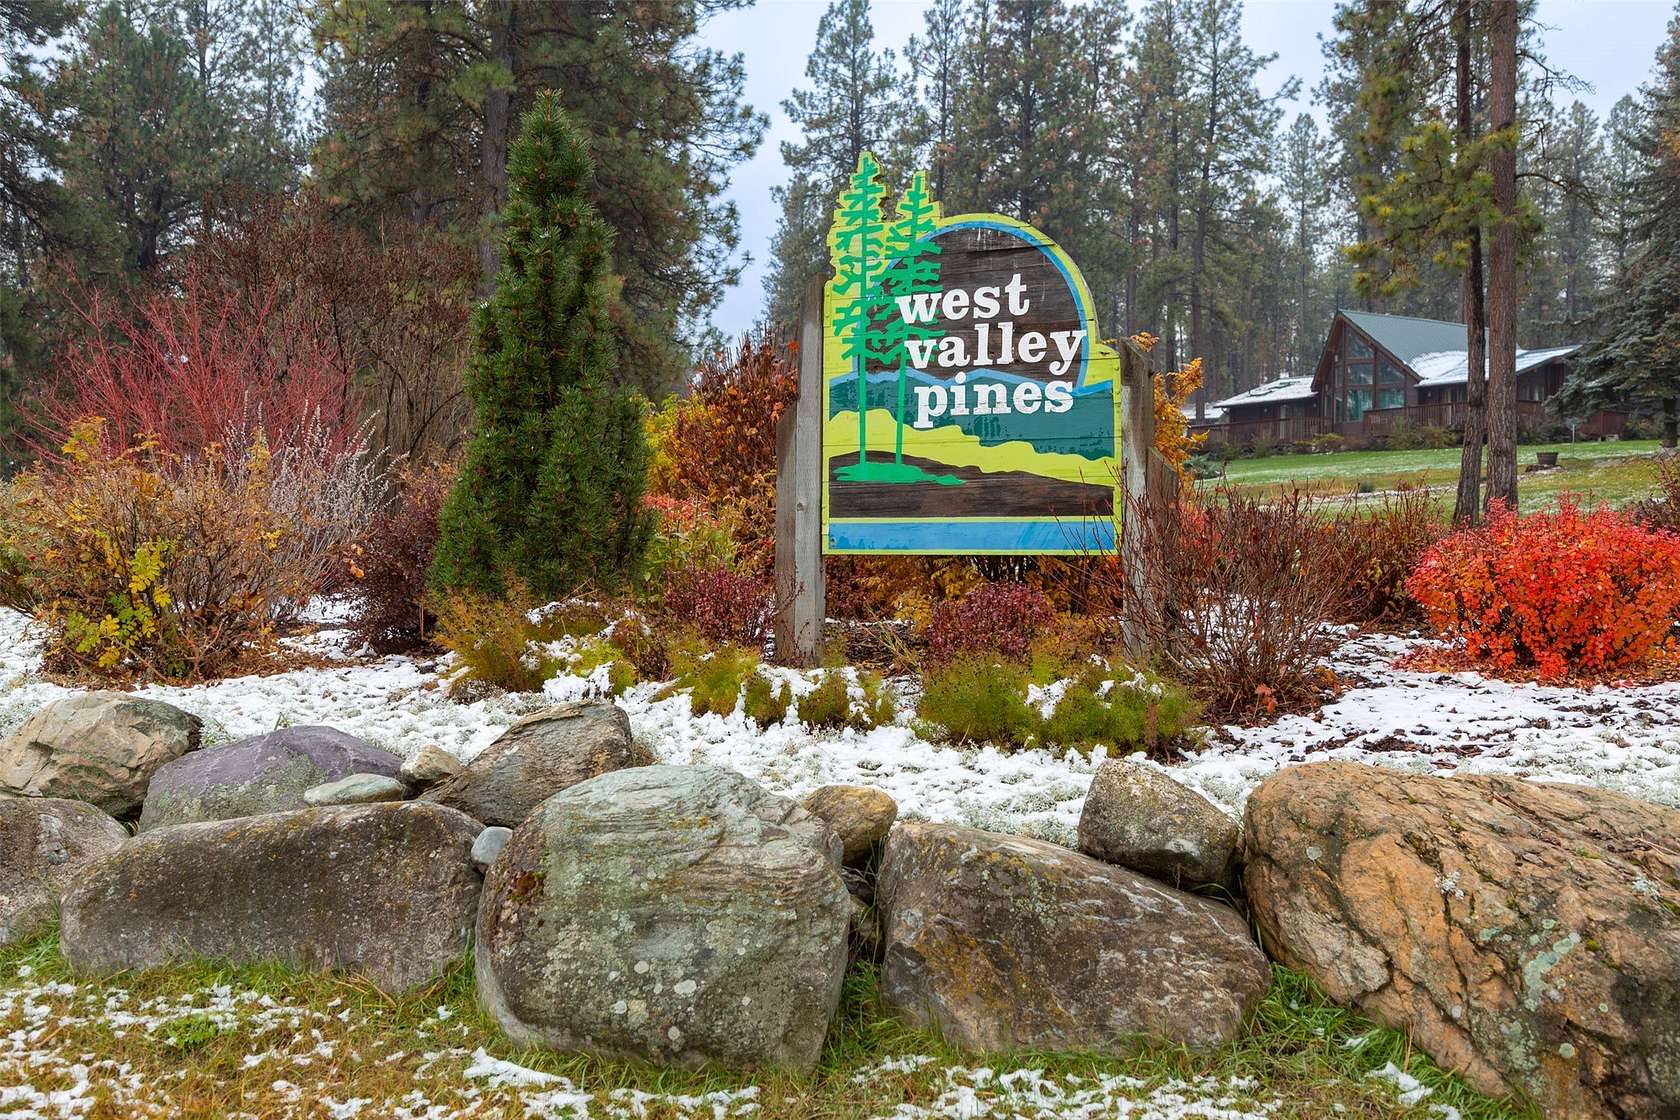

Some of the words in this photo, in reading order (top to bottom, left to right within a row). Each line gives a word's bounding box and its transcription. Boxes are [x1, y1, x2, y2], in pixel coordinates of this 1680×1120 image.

[895, 273, 1030, 324] west
[904, 322, 1087, 375] valley
[913, 371, 1074, 429] pines
